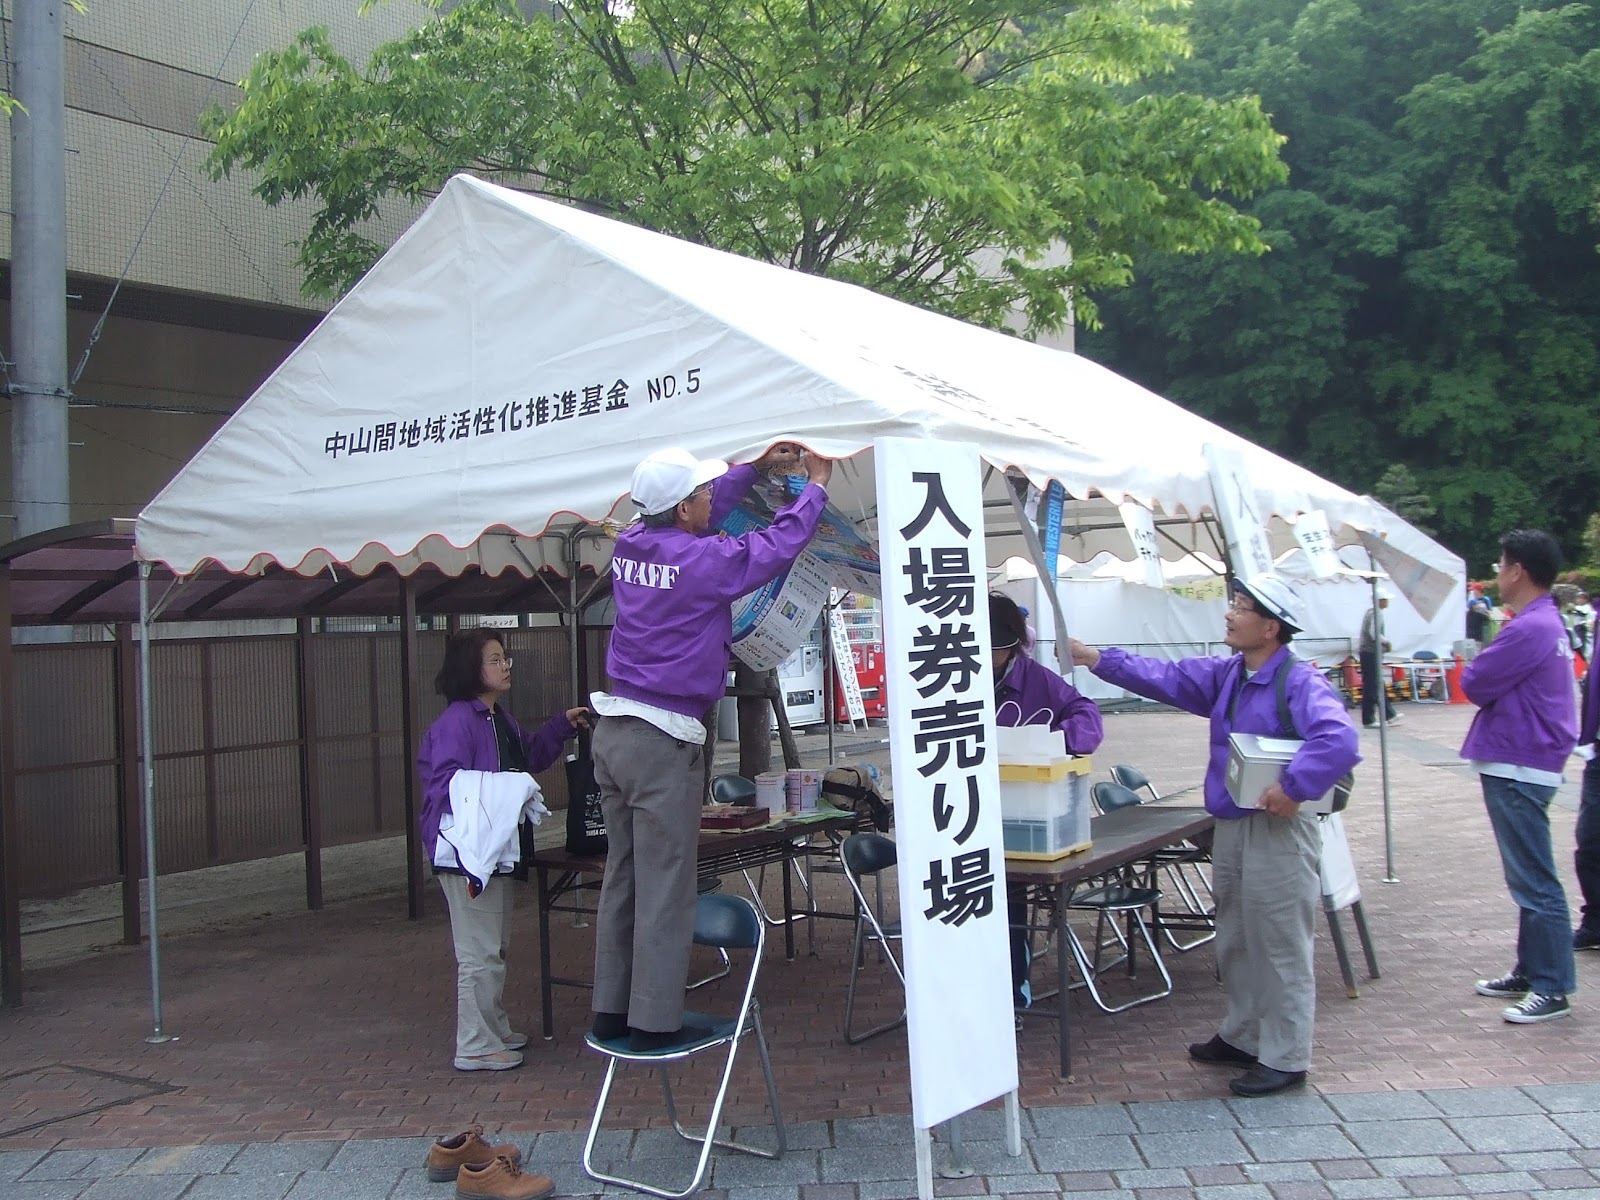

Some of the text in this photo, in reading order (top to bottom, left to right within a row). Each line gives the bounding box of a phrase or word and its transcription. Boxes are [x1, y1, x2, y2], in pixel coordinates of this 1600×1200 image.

[324, 378, 630, 459] 中山間地域活性化推進基金
[612, 556, 680, 590] STAFF
[899, 471, 995, 929] 入場券売り場
